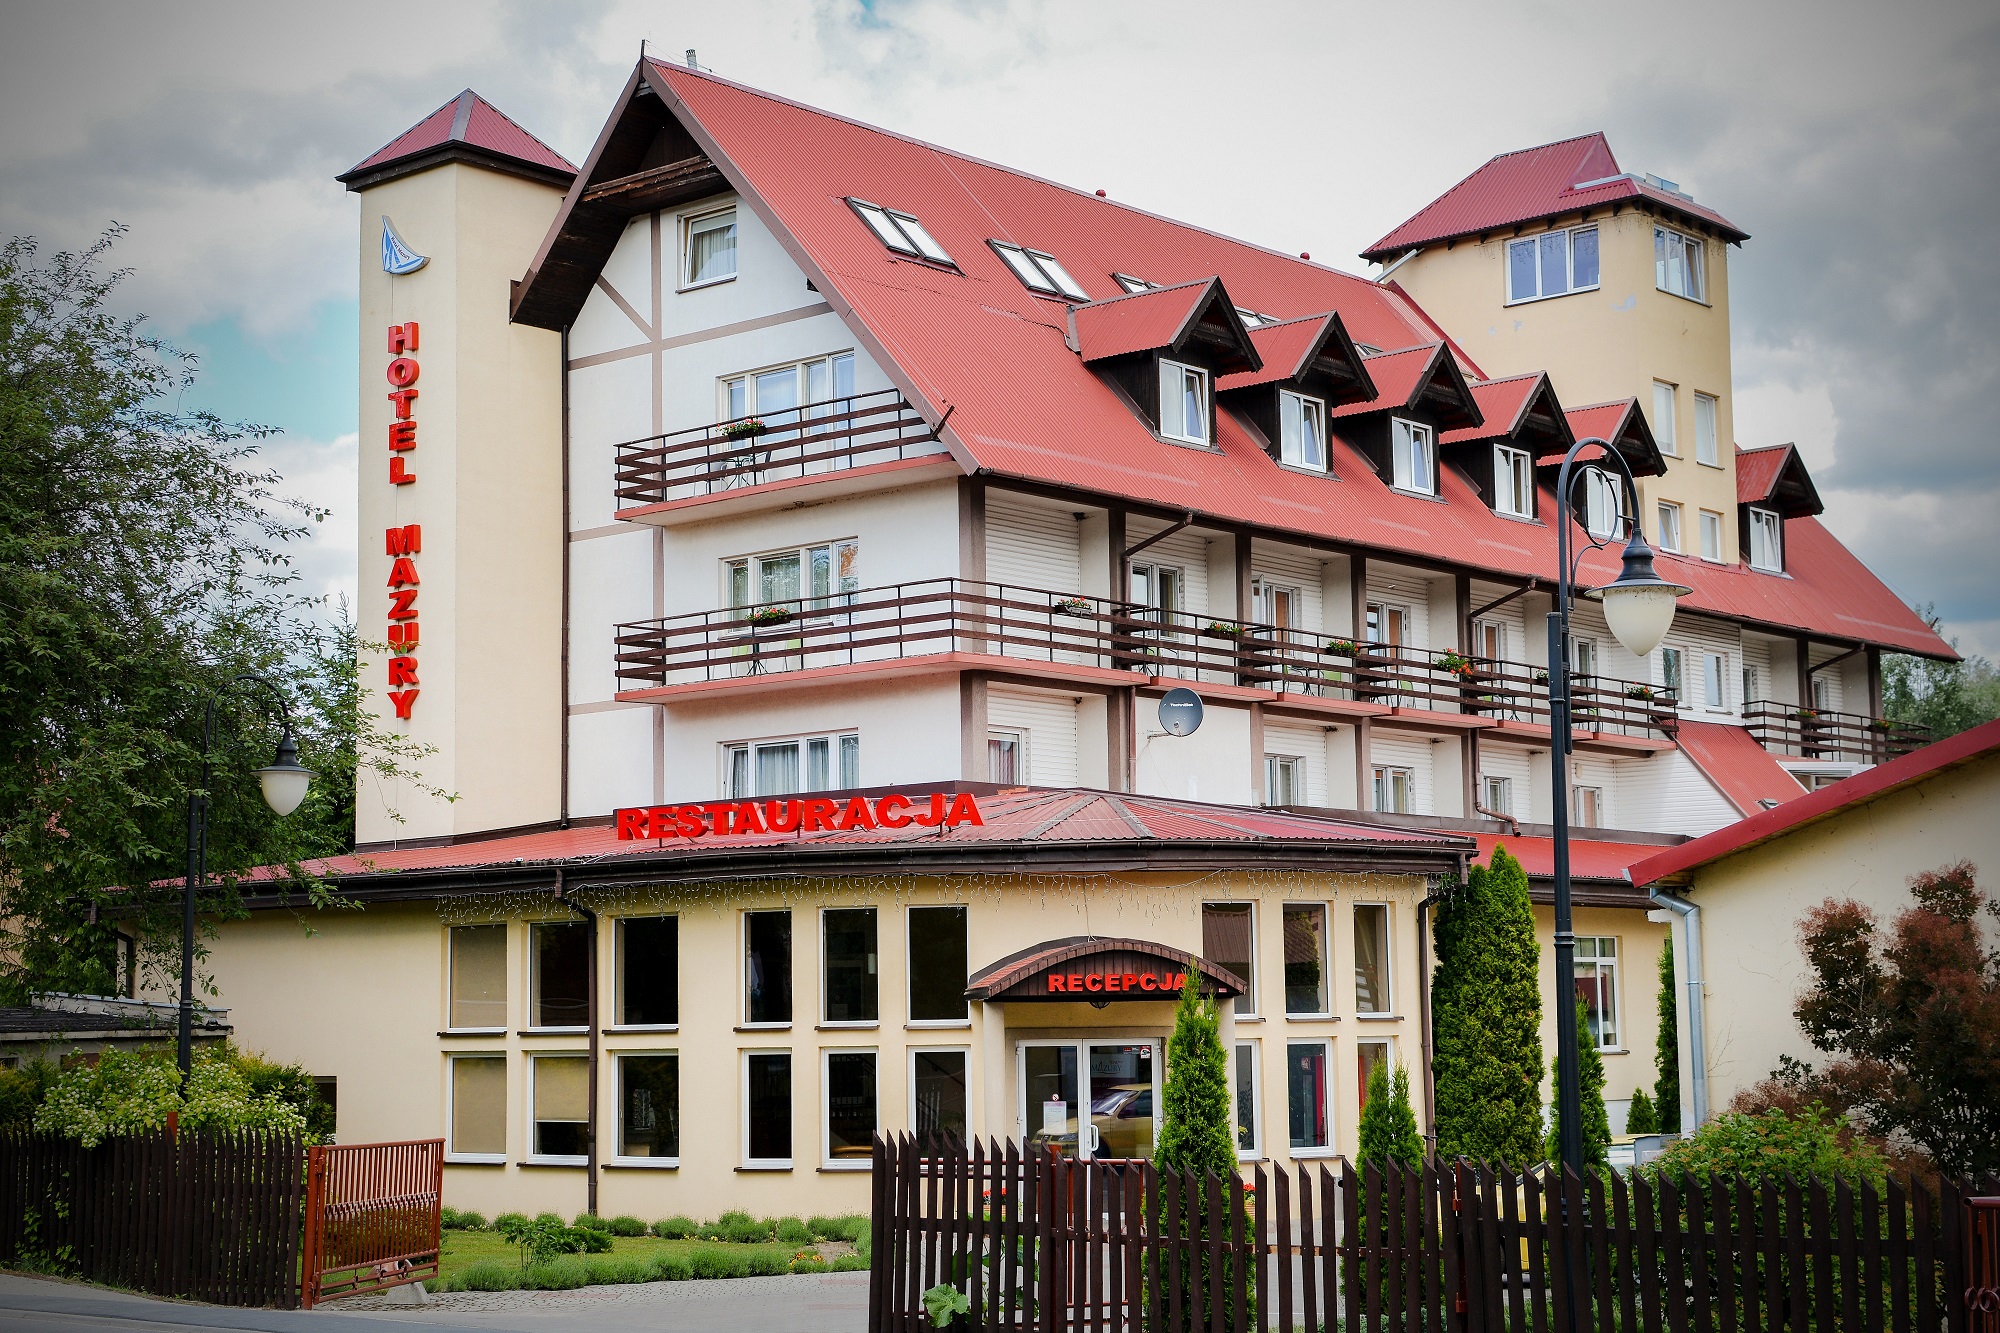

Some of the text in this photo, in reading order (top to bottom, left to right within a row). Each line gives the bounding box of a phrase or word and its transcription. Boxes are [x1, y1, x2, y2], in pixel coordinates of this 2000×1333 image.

[385, 321, 421, 720] HOTEL MAZURY
[617, 792, 985, 841] RESTAURACJA
[1048, 973, 1188, 991] RECEPCJA
